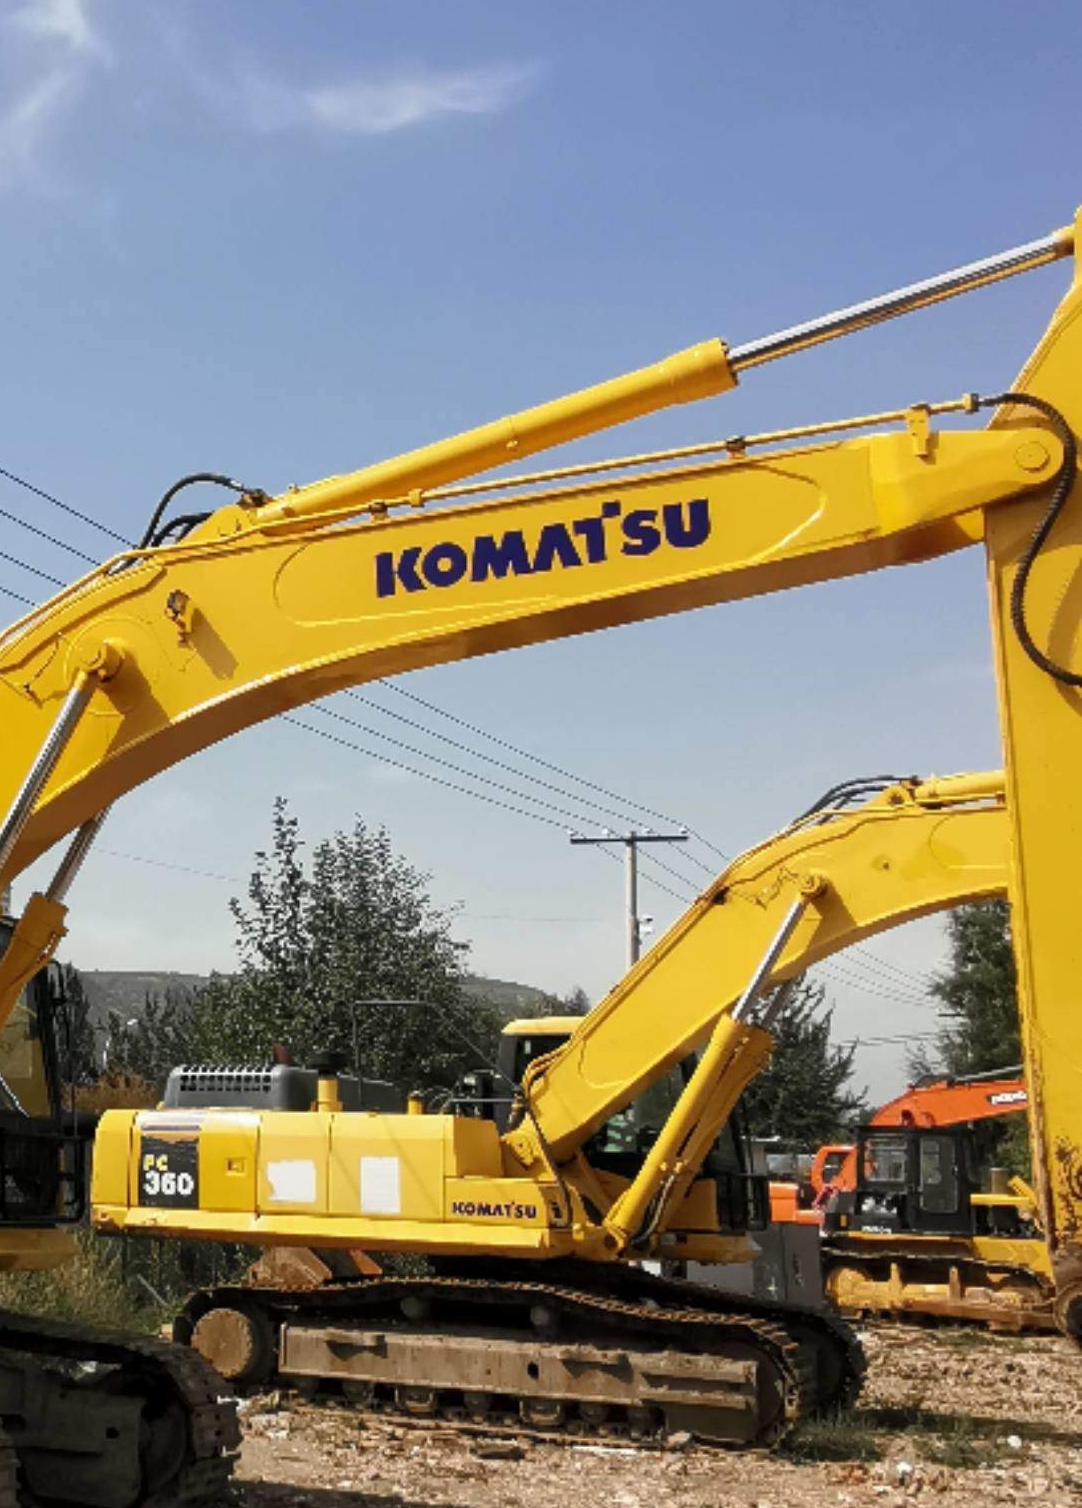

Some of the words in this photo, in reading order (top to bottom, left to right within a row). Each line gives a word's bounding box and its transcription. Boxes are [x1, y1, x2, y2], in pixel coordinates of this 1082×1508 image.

[375, 499, 711, 598] KOMATSU
[143, 1153, 168, 1171] PC
[143, 1170, 194, 1196] 360
[452, 1201, 536, 1219] KOMATSU
